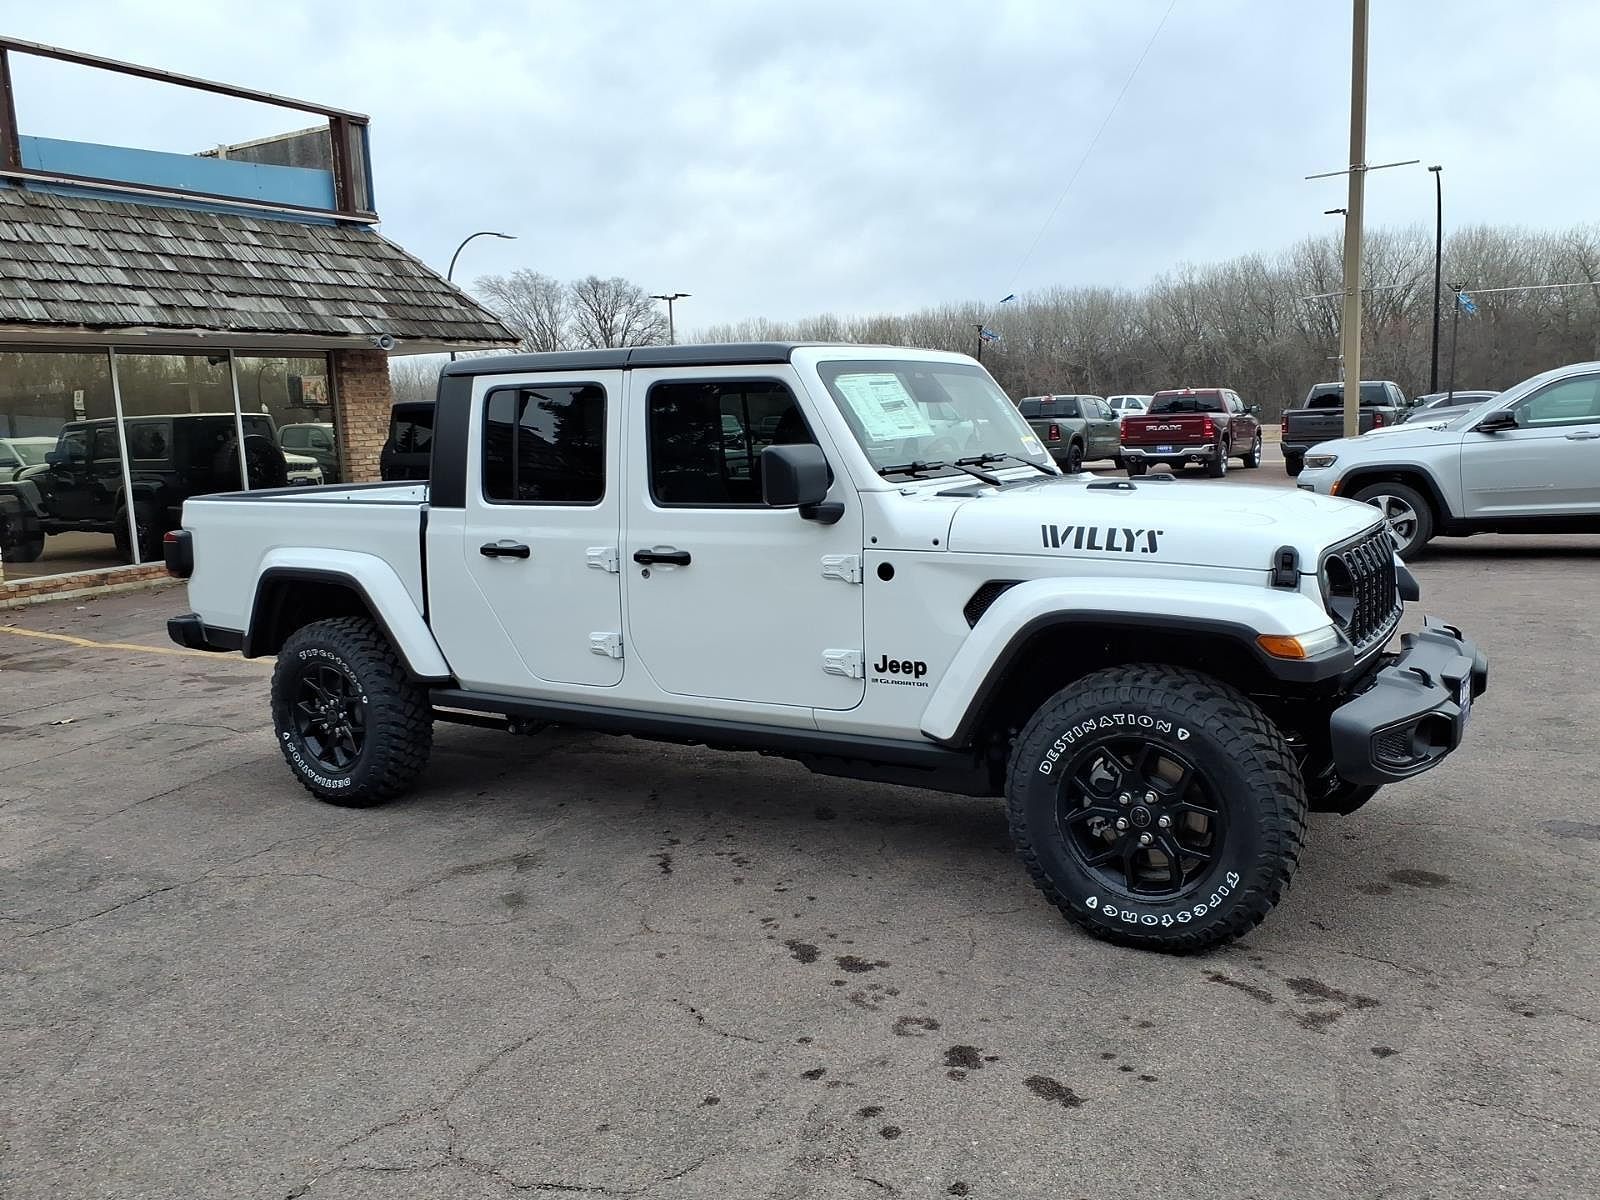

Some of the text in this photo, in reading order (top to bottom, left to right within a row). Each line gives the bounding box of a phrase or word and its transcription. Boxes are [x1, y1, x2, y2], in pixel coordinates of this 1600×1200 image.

[1041, 524, 1164, 553] WILLYS
[873, 654, 928, 679] Jeep
[1039, 713, 1172, 775] DESTINATION
[1103, 871, 1240, 927] Firestone
